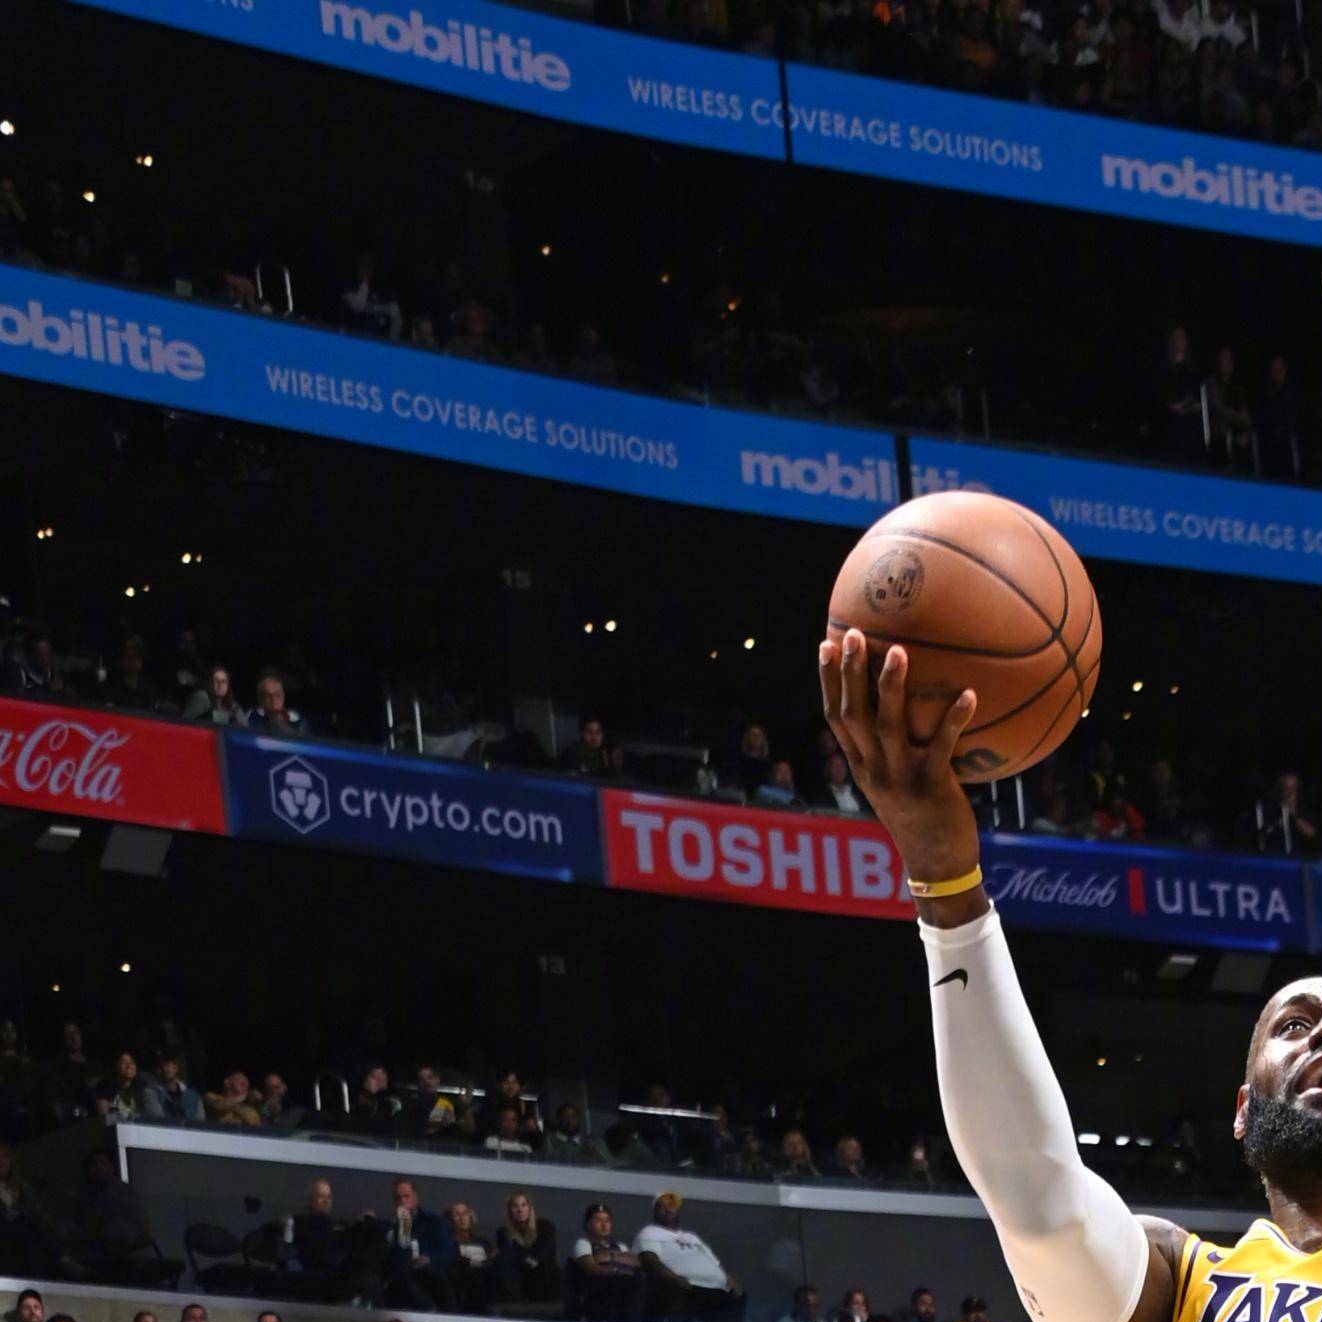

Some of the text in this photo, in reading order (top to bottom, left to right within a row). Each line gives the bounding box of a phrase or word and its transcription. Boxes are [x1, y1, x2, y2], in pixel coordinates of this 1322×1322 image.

[319, 0, 572, 91] mobilitie
[627, 74, 742, 122] WIRELESS
[751, 99, 902, 149] COVERAGE
[909, 126, 1043, 172] SOLUTIONS
[266, 363, 382, 413] WIRELESS
[391, 390, 538, 444] COVERAGE
[545, 420, 679, 471] SOLUTIONS
[1048, 495, 1156, 535] WIRELESS
[1164, 509, 1296, 552] COVERAGE
[339, 782, 564, 846] crypto.com
[620, 808, 914, 903] TOSHIB
[984, 862, 1292, 925] Michelob ULTRA
